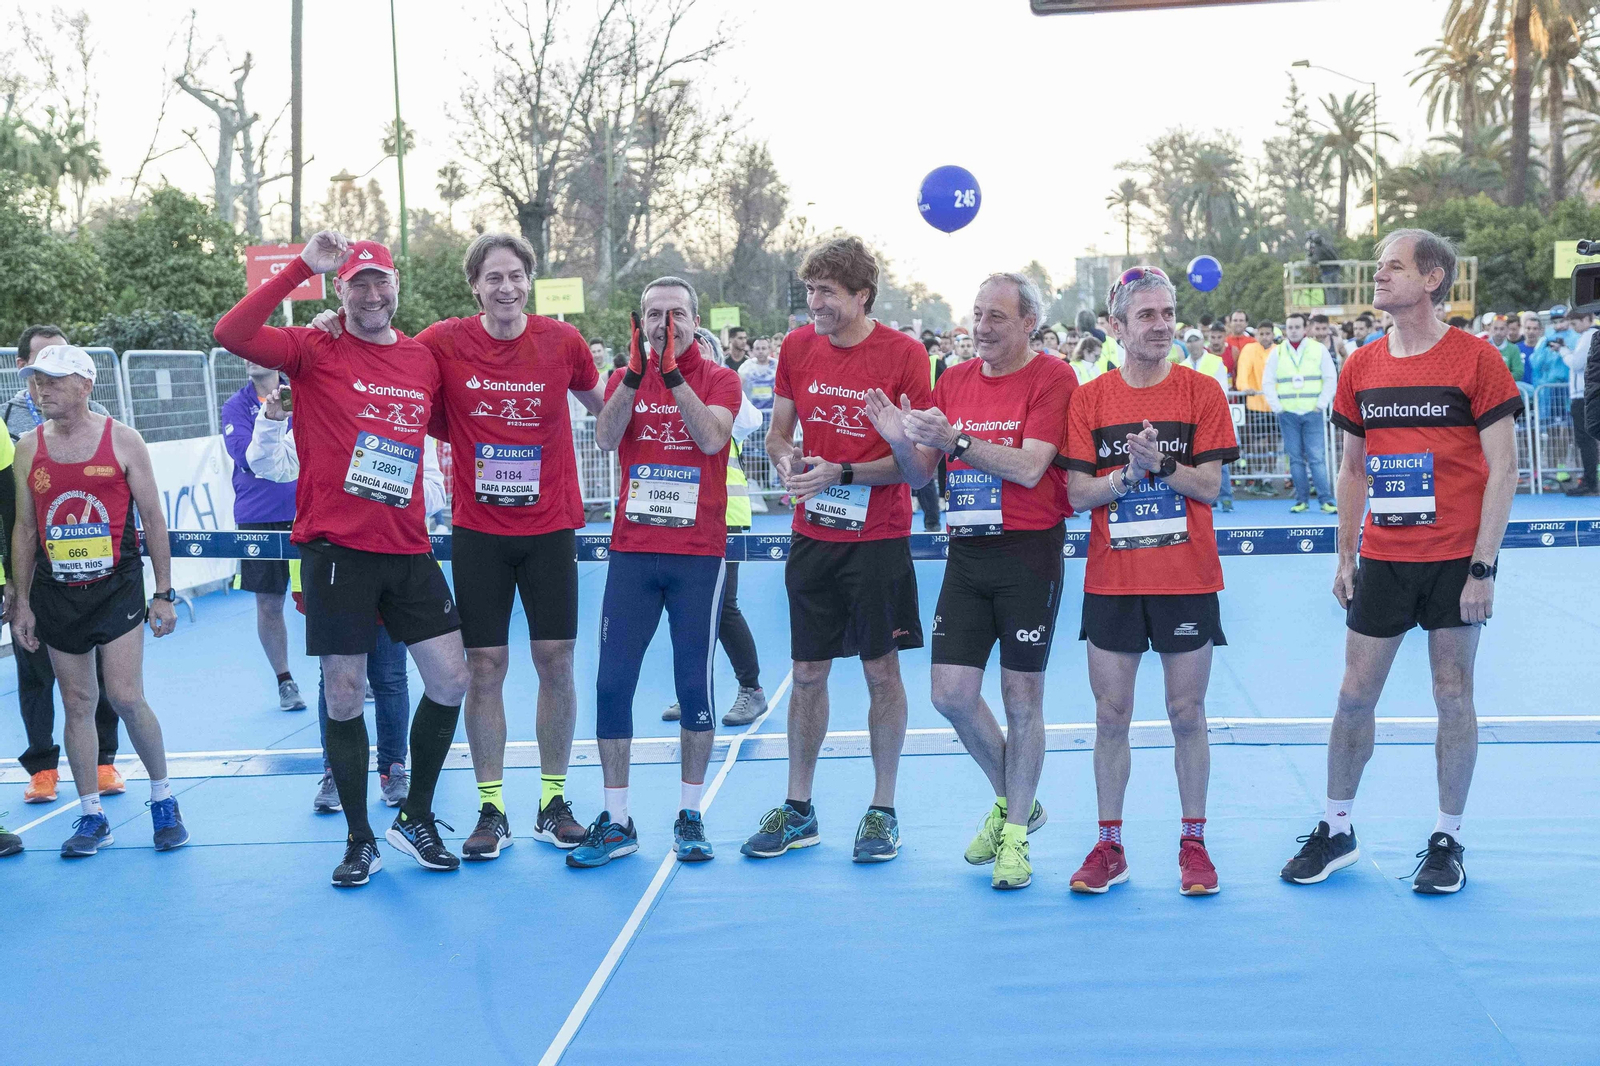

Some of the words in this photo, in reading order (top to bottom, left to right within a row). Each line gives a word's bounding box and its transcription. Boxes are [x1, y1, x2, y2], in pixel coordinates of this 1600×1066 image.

[954, 189, 976, 208] 2:45
[483, 379, 545, 392] Santander
[368, 384, 424, 400] Santander
[819, 383, 866, 400] Santand
[1367, 402, 1449, 419] Santander
[965, 420, 1021, 432] Santander
[381, 442, 415, 459] ZURICH
[497, 449, 534, 458] ZURICH
[372, 460, 402, 477] 12891
[1383, 459, 1423, 469] ZURICH
[495, 470, 522, 480] 8184
[653, 469, 692, 480] ZURICH
[956, 474, 992, 483] ZURICH
[351, 472, 381, 488] GARCÍA
[382, 482, 409, 496] AGUADO
[481, 483, 499, 492] RAFA
[501, 485, 533, 493] PASCUAL
[1385, 480, 1405, 492] 373
[648, 490, 680, 501] 10846
[820, 486, 850, 500] 4022
[957, 495, 975, 505] 375
[649, 505, 672, 514] SORIA
[816, 503, 847, 516] SALINAS
[1135, 504, 1158, 515] 374
[1530, 522, 1566, 530] ZURICH
[64, 527, 102, 537] ZURICH
[1230, 530, 1264, 538] ZURICH
[1290, 529, 1324, 537] ZURICH
[69, 548, 88, 558] 666
[85, 560, 103, 568] RÍOS
[1016, 629, 1040, 642] GO
